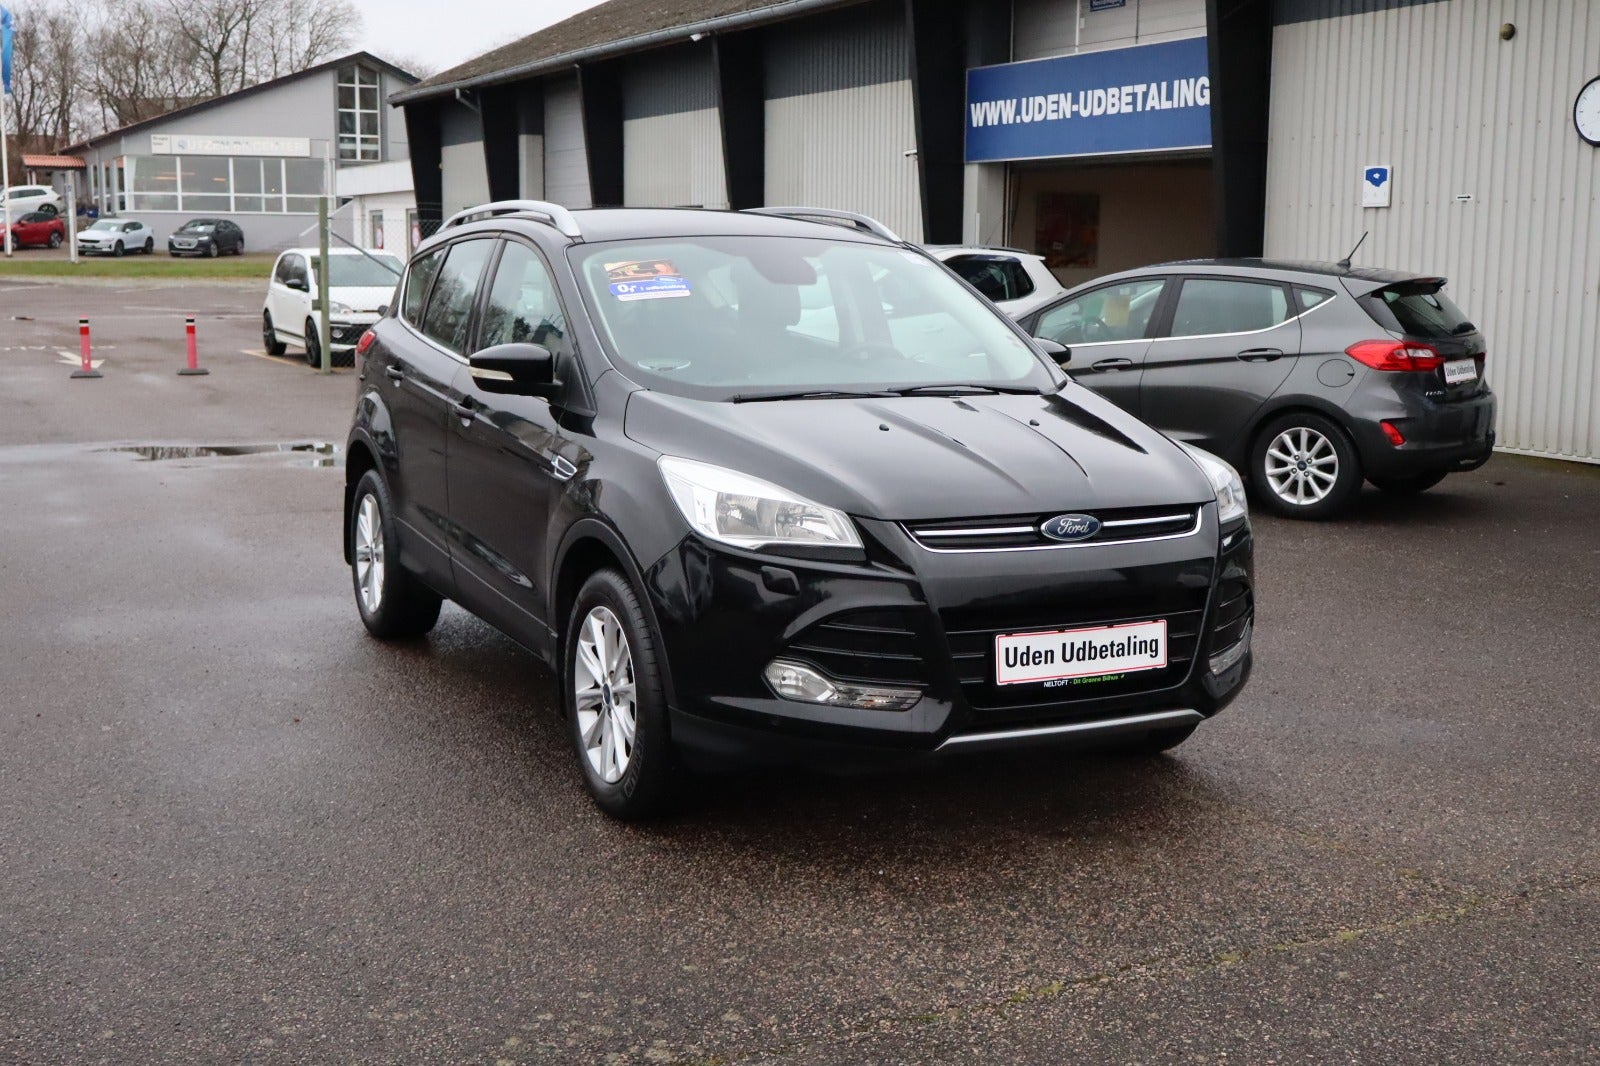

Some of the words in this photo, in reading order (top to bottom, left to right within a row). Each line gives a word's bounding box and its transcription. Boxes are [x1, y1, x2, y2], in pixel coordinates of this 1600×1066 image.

[970, 76, 1211, 128] WWW.UDEN-UDBETALING
[1057, 517, 1090, 535] Ford
[1004, 645, 1055, 669] Uden
[1061, 635, 1159, 663] Udbetaling
